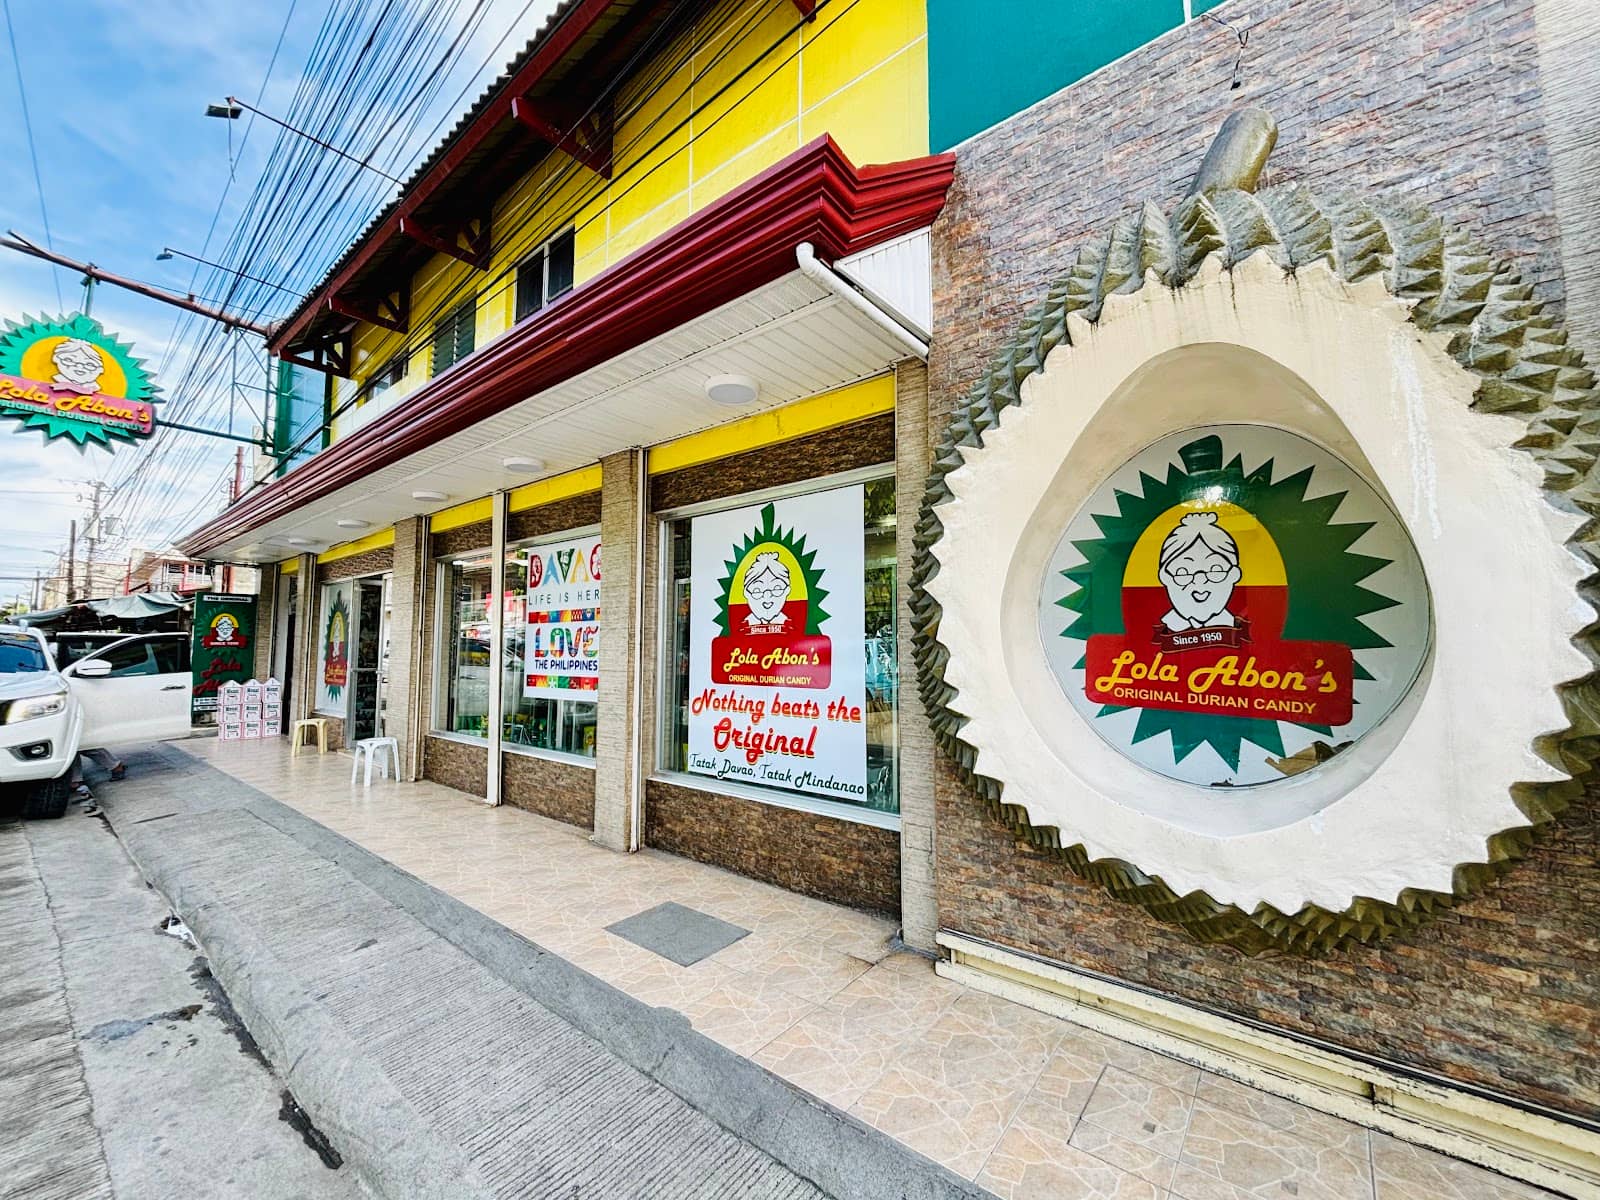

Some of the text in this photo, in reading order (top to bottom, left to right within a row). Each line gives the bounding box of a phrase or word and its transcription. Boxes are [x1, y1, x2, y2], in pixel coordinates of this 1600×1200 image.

[54, 395, 149, 423] Abon's
[529, 589, 600, 606] LIFE IS HER
[535, 626, 599, 658] LOVE
[1173, 631, 1222, 646] Since 1950
[535, 659, 598, 671] THE PHILIPPINES
[723, 647, 820, 672] Lola Abon's
[1095, 650, 1337, 694] Lola Abon's
[729, 674, 811, 685] ORIGINAL DURIAN CANDY
[692, 688, 862, 724] Nothing beats the
[1114, 686, 1317, 715] ORIGINAL DURIAN CANDY
[713, 717, 818, 764] Original
[690, 753, 865, 795] Tatak Davao, Tatak Mindanao
